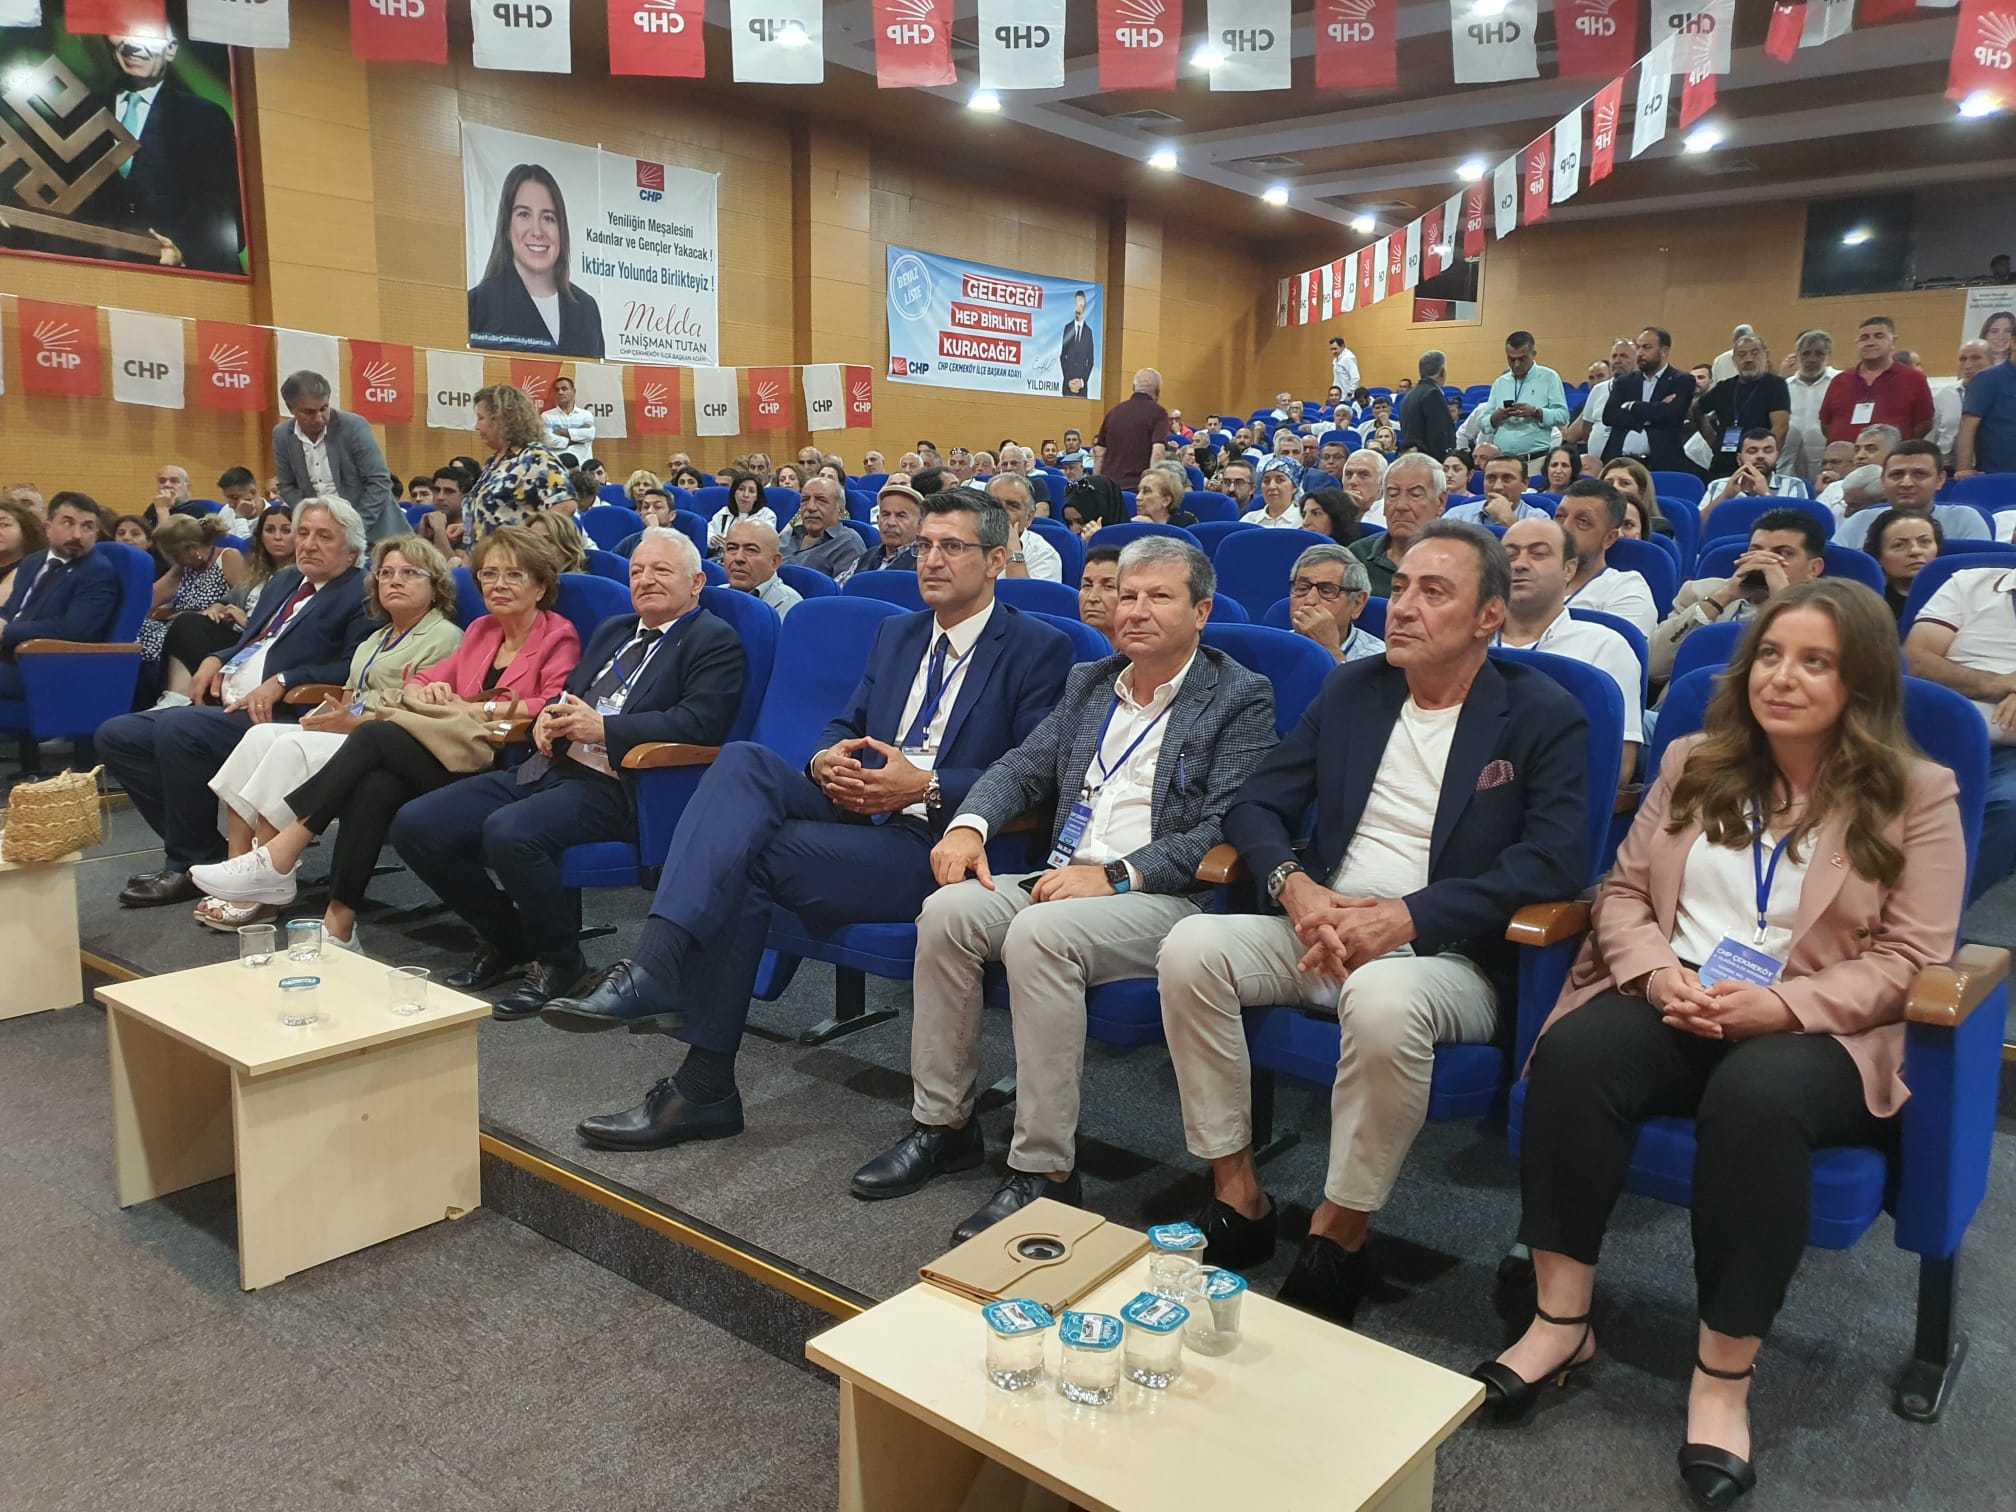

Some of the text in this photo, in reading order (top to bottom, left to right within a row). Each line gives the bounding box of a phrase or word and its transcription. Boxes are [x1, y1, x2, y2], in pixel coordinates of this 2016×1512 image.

[639, 189, 663, 203] CHP
[608, 211, 694, 239] Yeniliğin Meşalesini
[586, 228, 623, 247] Kadınlar
[625, 237, 636, 249] ve
[638, 237, 672, 256] Gençler
[673, 242, 708, 261] Yakacak
[581, 251, 615, 278] İktidar
[618, 260, 658, 284] Yolunda
[661, 267, 709, 293] Birlikteyiz
[897, 266, 919, 287] BEYAZ
[967, 279, 1039, 308] GELECEĞİ
[624, 300, 702, 337] Melda
[955, 309, 1028, 333] HEP BİRLİKTE
[618, 333, 707, 353] TANİŞMAN TUTAN
[943, 337, 1017, 362] KURACAĞIZ
[36, 350, 81, 369] CHP
[909, 361, 929, 375] CHP
[123, 359, 169, 380] CHP
[937, 361, 1022, 378] CHP ÇEKMEKÖY İLÇE BAŞKAN ADAYI
[211, 372, 251, 389] CHP
[1027, 379, 1060, 391] YILDIRIM
[365, 388, 397, 403] CHP
[437, 390, 471, 407] CHP
[644, 405, 668, 418] CHP
[704, 403, 727, 417] CHP
[758, 402, 780, 414] CHP
[812, 399, 833, 413] CHP
[853, 402, 871, 413] CHP
